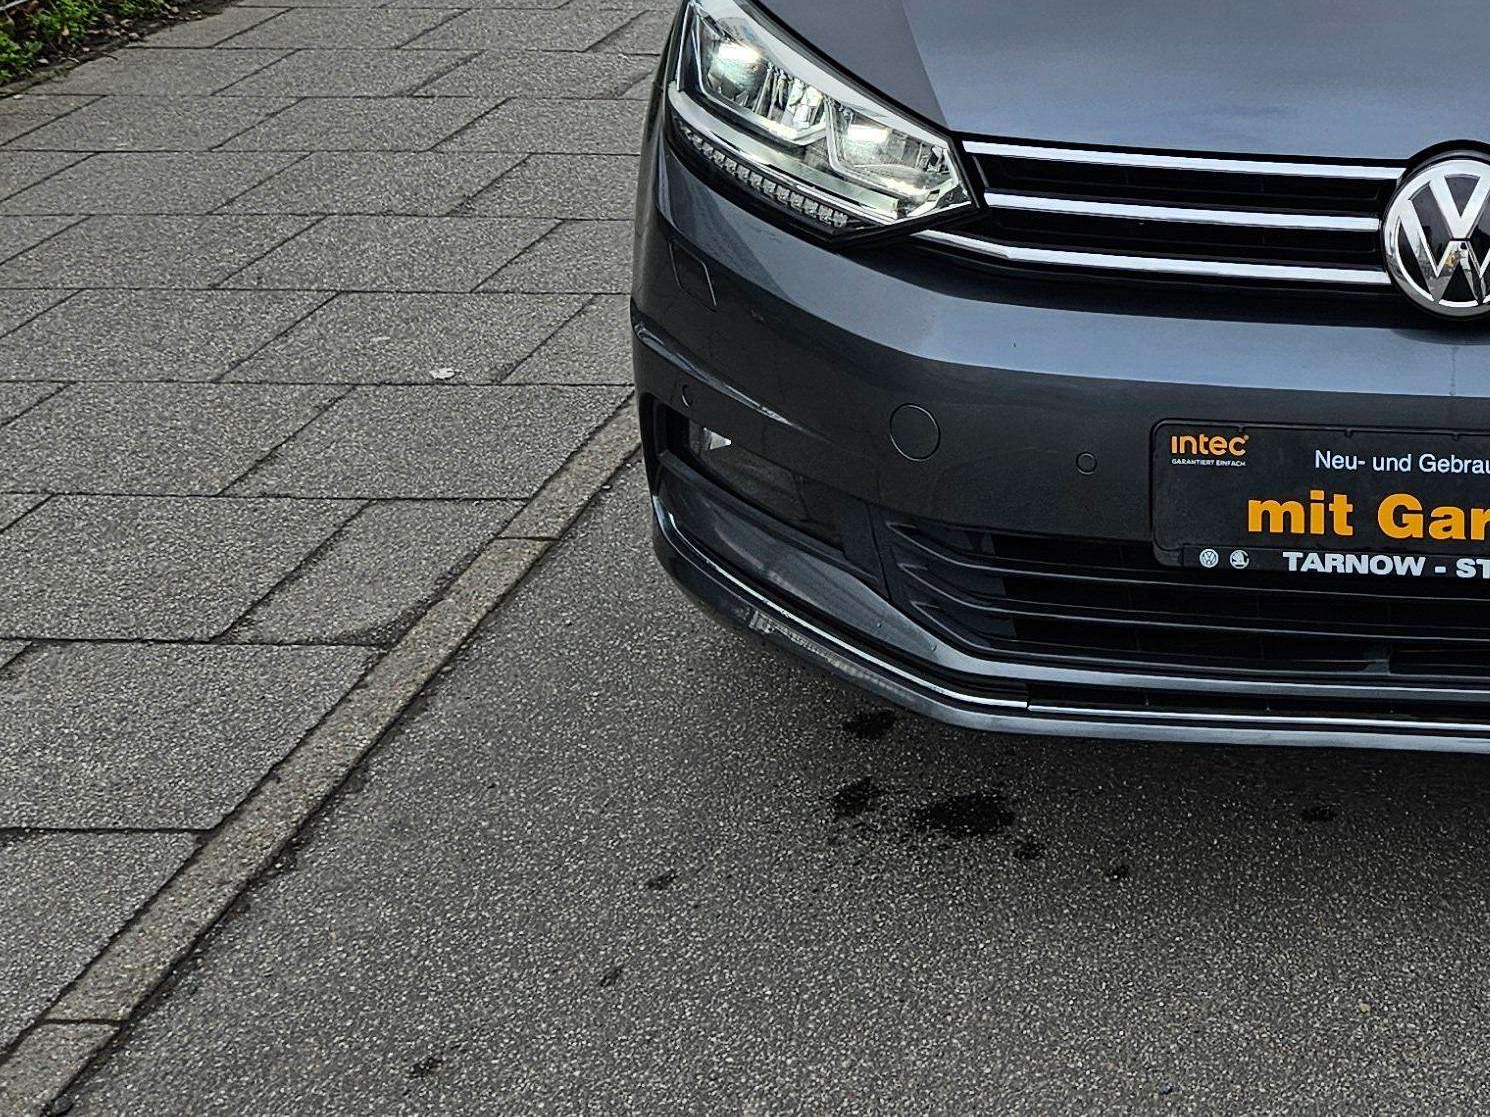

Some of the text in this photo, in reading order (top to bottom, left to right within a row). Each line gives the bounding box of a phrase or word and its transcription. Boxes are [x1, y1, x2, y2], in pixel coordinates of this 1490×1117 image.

[1315, 449, 1366, 471] Neu-
[1372, 453, 1412, 472] und
[1248, 489, 1354, 537] mit
[1283, 551, 1426, 577] TARNOW
